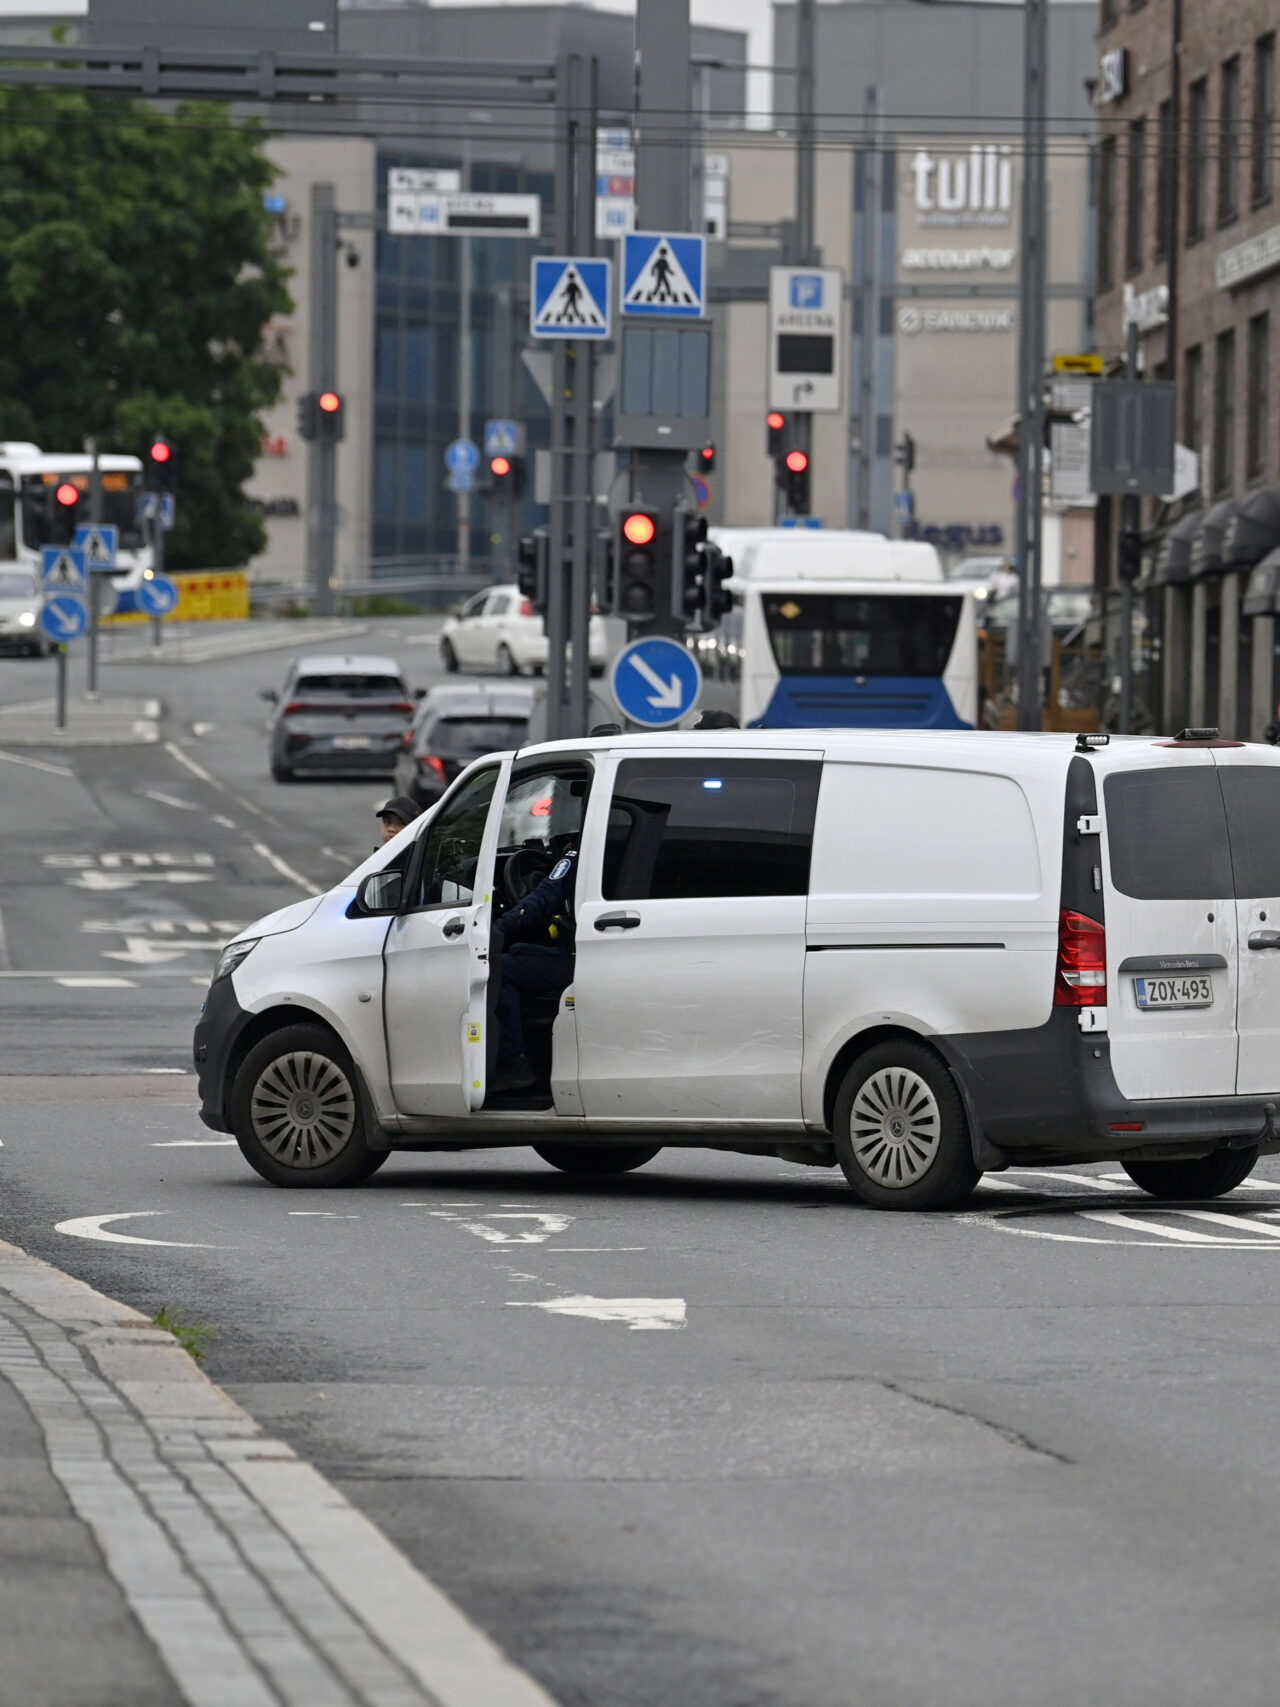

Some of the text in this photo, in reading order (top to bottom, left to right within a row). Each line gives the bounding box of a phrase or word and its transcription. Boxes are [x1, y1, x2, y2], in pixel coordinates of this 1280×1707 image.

[911, 145, 1012, 210] tulli
[1159, 960, 1199, 969] Mercedes-Benz
[1148, 979, 1209, 1002] ZOX-493
